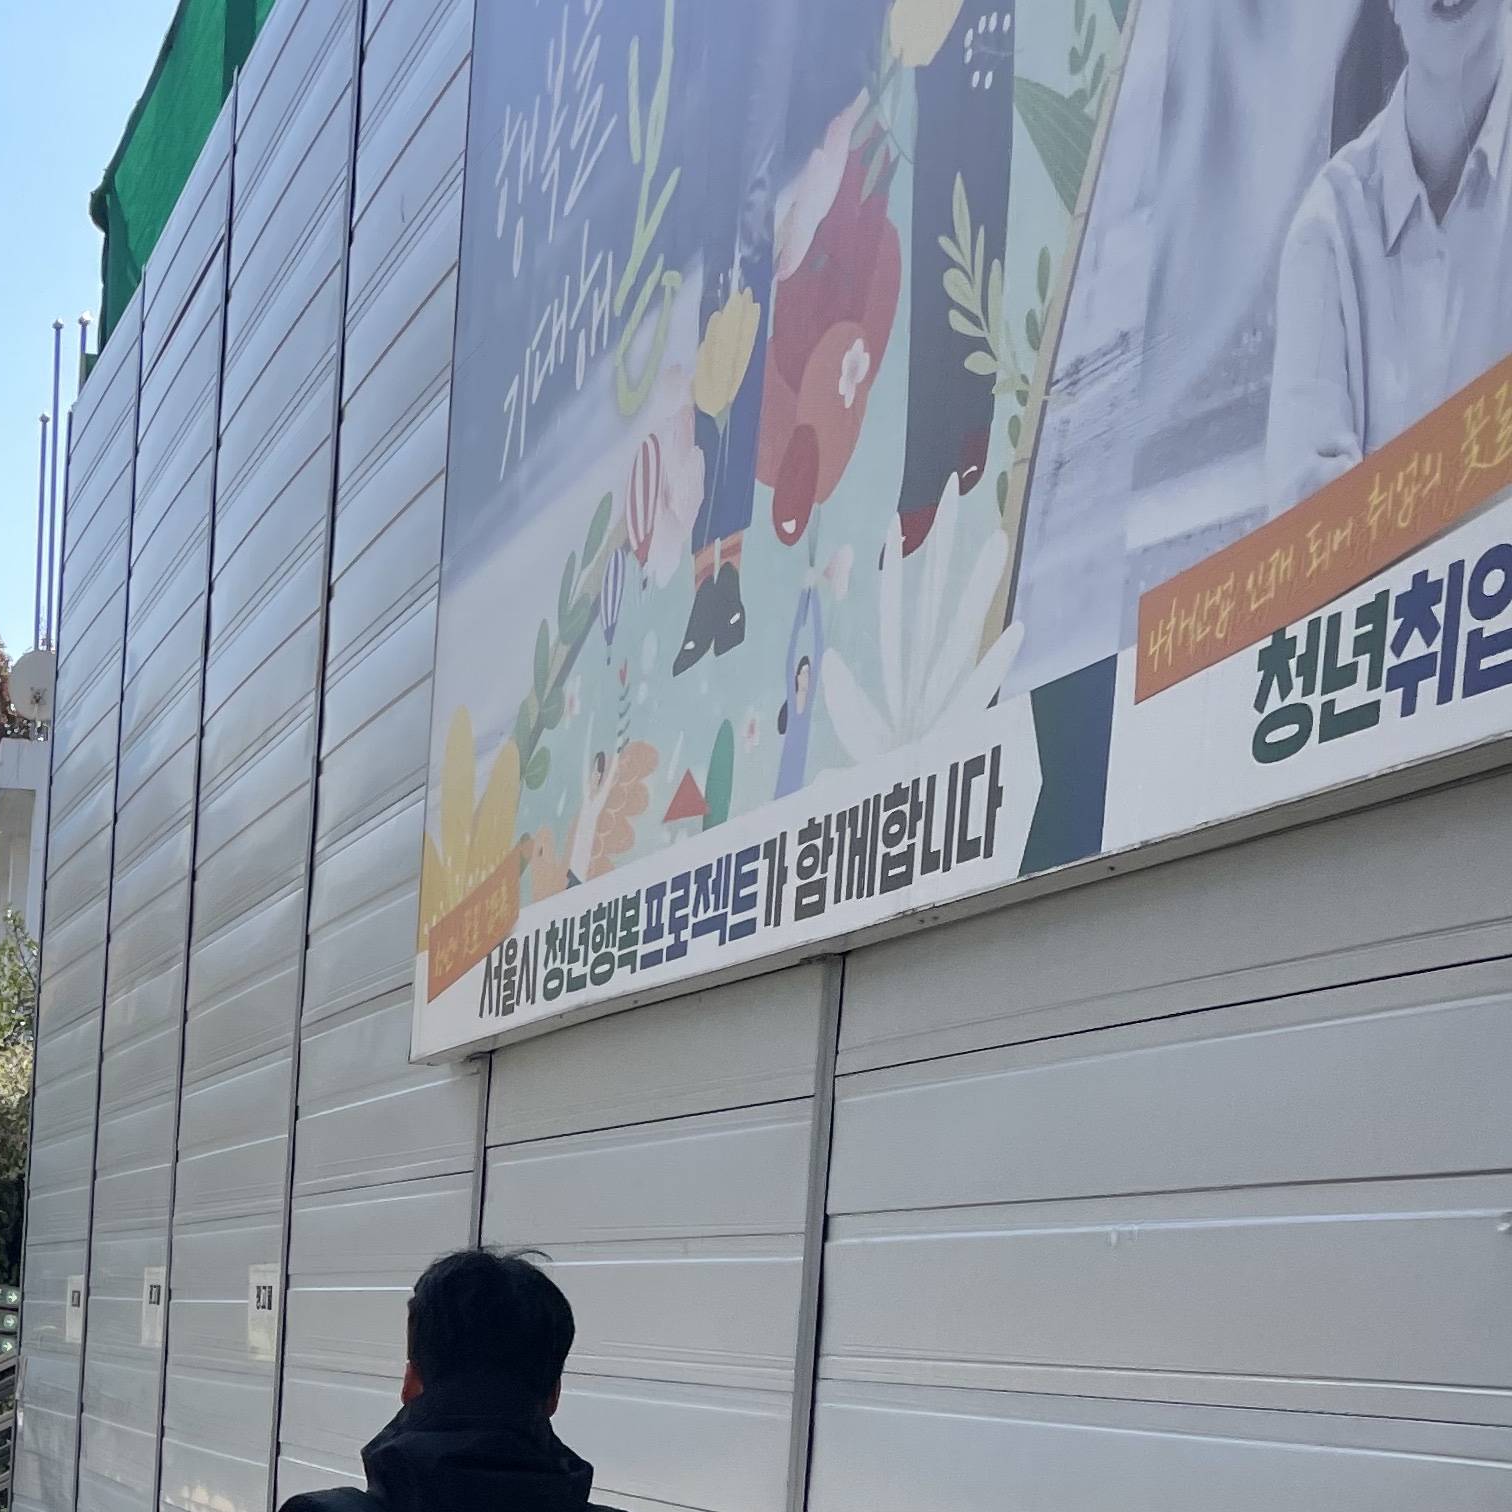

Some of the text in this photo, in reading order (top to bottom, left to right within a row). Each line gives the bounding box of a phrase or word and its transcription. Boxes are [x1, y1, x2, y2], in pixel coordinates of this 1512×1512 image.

[498, 218, 614, 482] 기대해
[478, 928, 541, 1019] 서울시
[542, 831, 789, 1002] 청년행복프로젝트가
[793, 744, 1004, 922] 함께합니다
